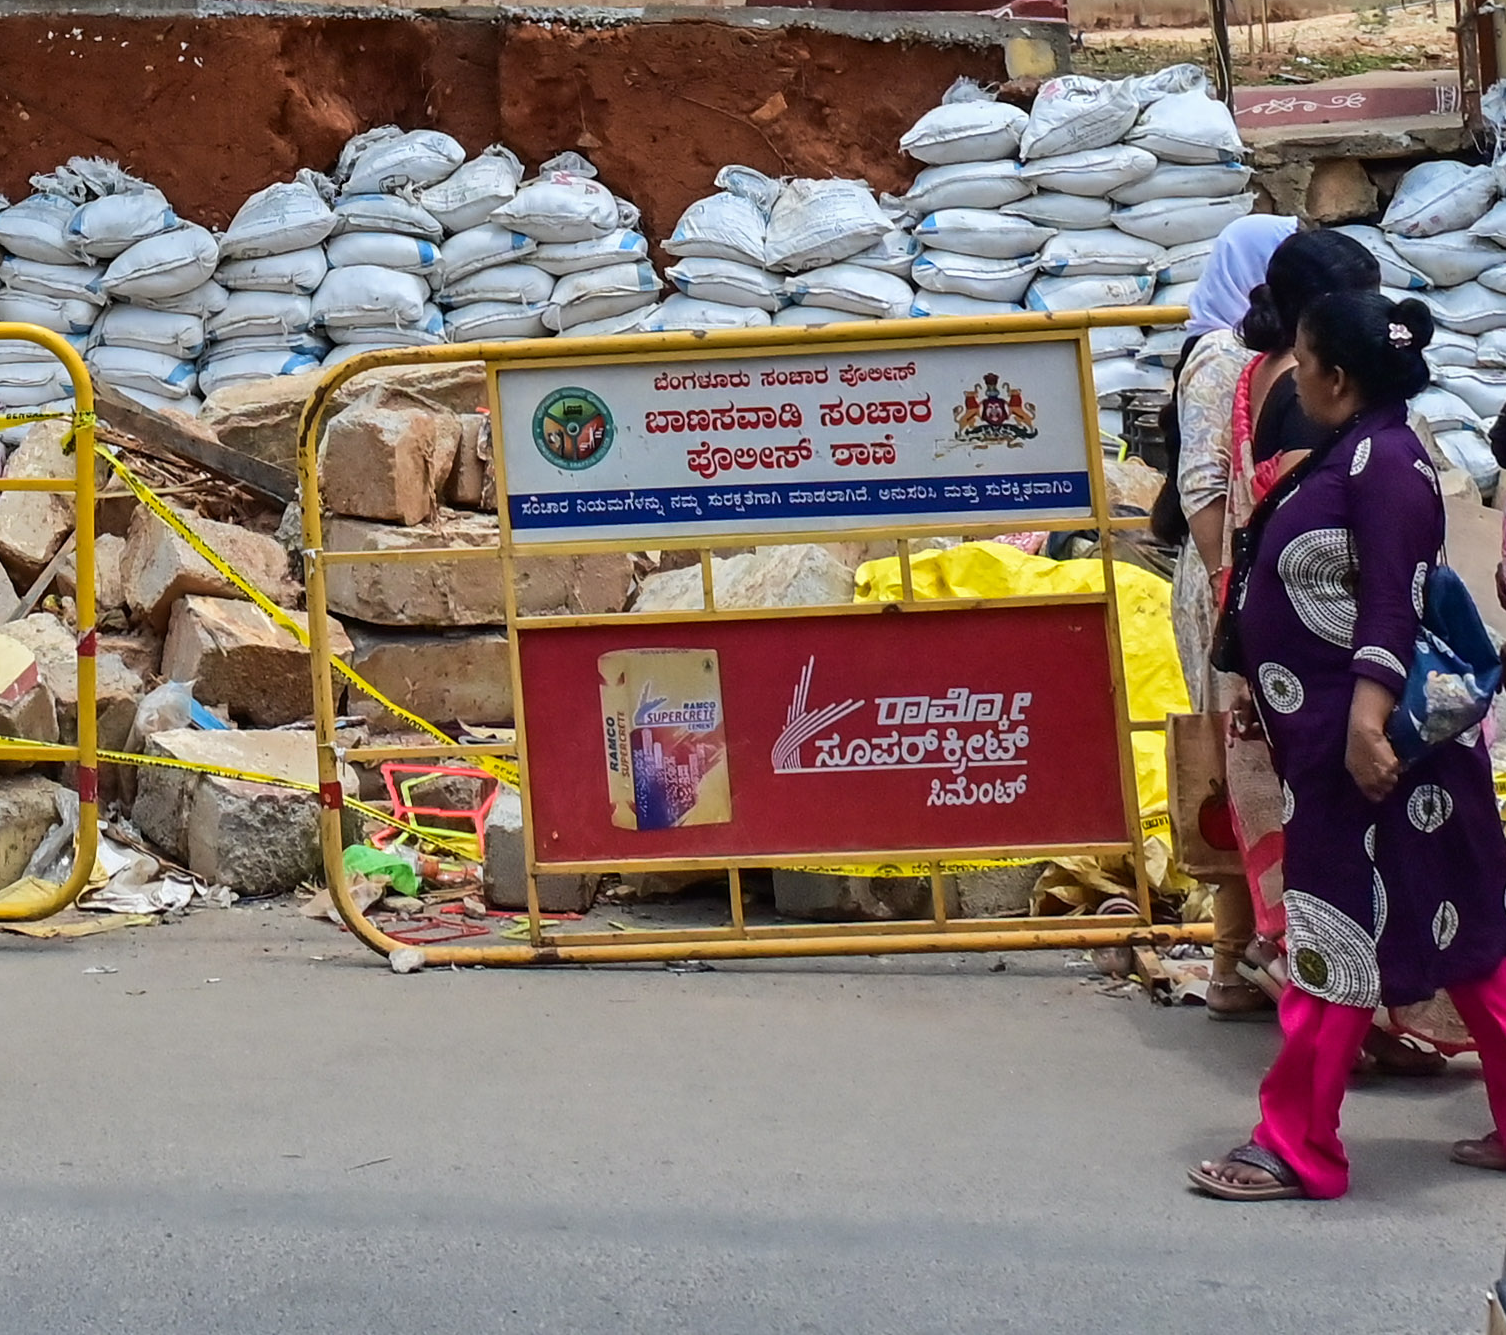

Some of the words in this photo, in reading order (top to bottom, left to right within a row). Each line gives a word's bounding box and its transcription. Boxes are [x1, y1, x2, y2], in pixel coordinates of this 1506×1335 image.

[654, 369, 751, 391] ಬೆಂಗಳೂರು
[761, 365, 829, 388] ಸಂಚಾರ
[839, 361, 916, 388] ಪೊಲೀಸ್
[645, 400, 803, 434] ಬಾಣಸವಾಡಿ
[820, 391, 933, 427] ಸಂಚಾರ
[687, 438, 812, 479] ಪೊಲೀಸ್
[522, 496, 568, 515] ಸಂಚಾರ
[670, 494, 702, 515] ನಮ್ಮ
[708, 490, 782, 512] ಸುರಕ್ಷತೆಗಾಗಿ
[789, 486, 872, 504] ಮಾಡಲಾಗಿದೆ.
[878, 486, 937, 501] ಅನುಸರಿಸಿ
[944, 484, 980, 503] ಮತ್ತು
[646, 710, 715, 724] SUPERCRETE
[683, 701, 716, 710] RAMCO
[688, 722, 715, 730] CEMENT
[606, 716, 619, 773] RAMCO
[617, 711, 630, 777] SUPERCRETE
[927, 775, 1028, 806] ಸಿಮೆಂಟ್
